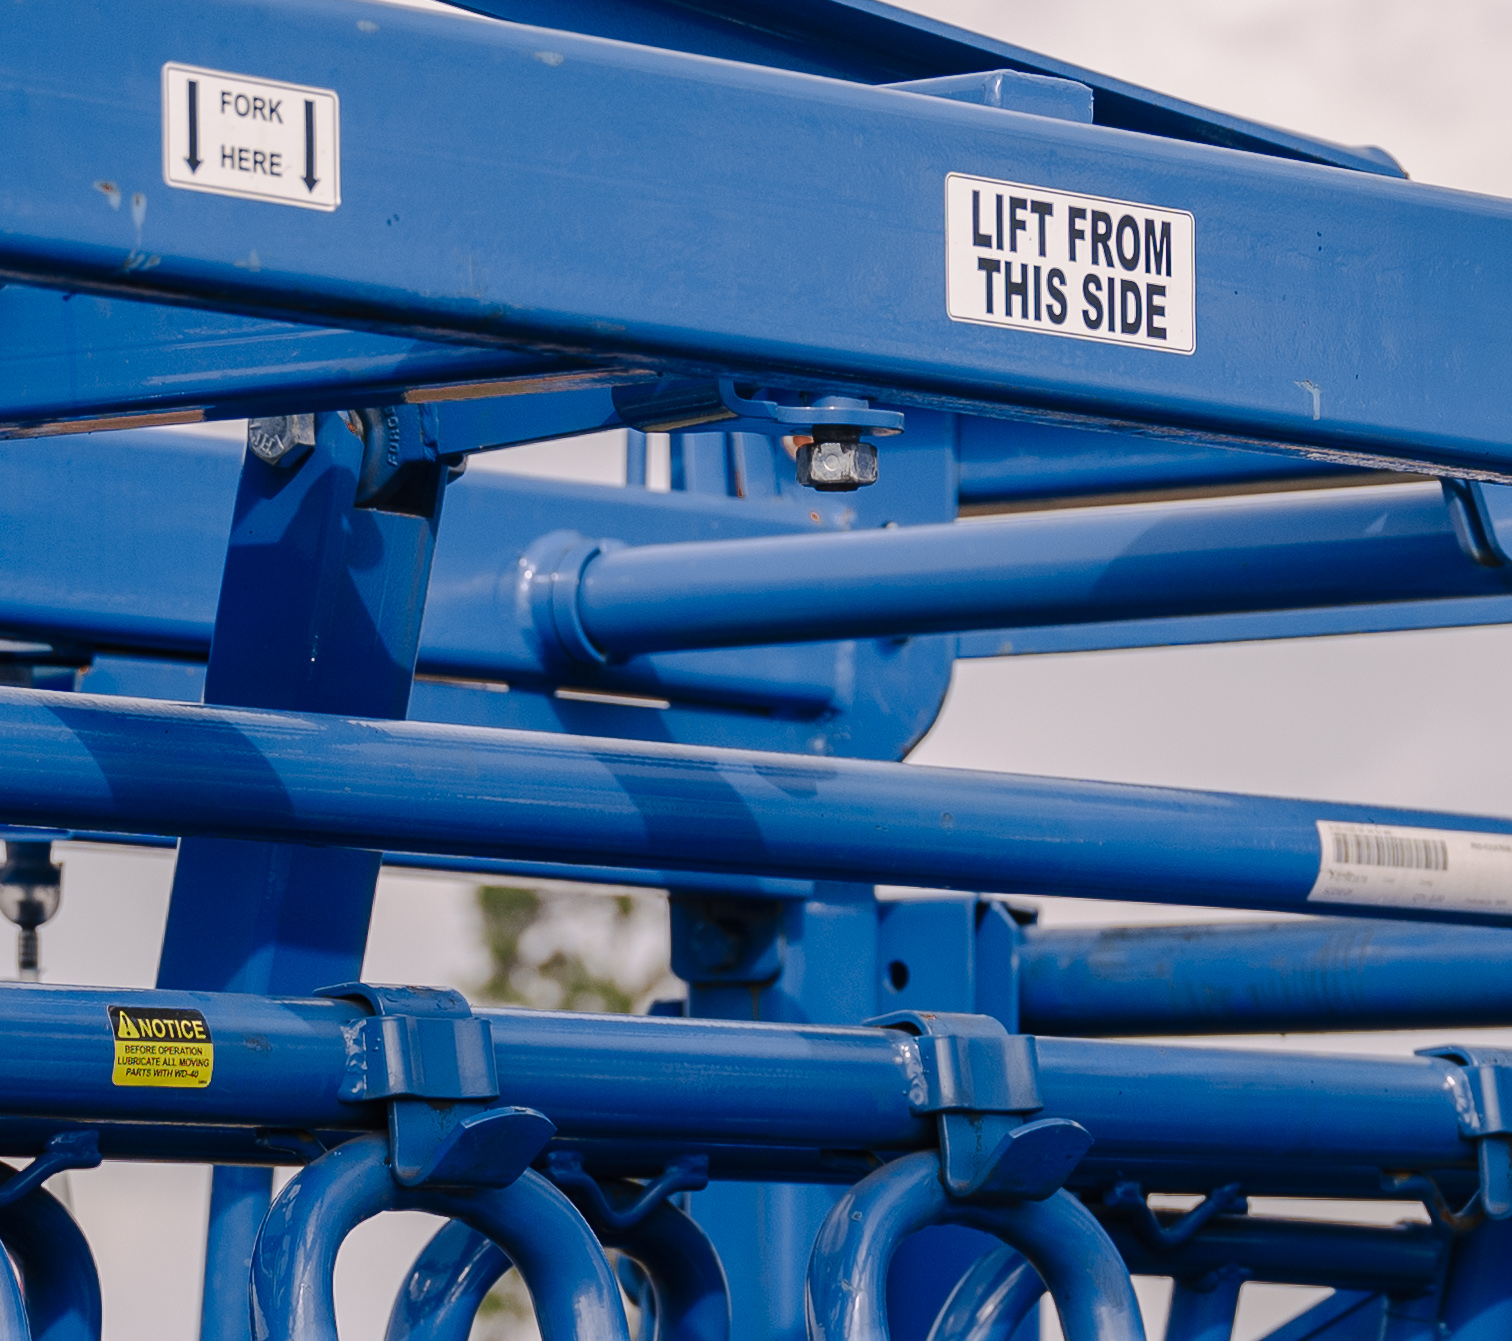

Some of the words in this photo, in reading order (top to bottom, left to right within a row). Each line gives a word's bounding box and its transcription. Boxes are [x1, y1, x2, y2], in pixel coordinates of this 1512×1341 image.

[221, 90, 284, 125] FORK
[221, 144, 283, 177] HERE
[972, 189, 1054, 258] LIFT
[1068, 205, 1173, 278] FROM
[977, 256, 1068, 326] THIS
[1082, 273, 1168, 341] SIDE
[138, 1018, 206, 1039] NOTICE
[117, 1056, 160, 1067] LUBRICATE
[162, 1057, 177, 1067] ALL
[179, 1057, 210, 1068] MOVING
[125, 1045, 156, 1054] BEFORE
[158, 1045, 203, 1056] OPERATION
[126, 1068, 152, 1078] PARTS
[154, 1068, 174, 1078] WITH
[175, 1069, 199, 1078] WD-40
